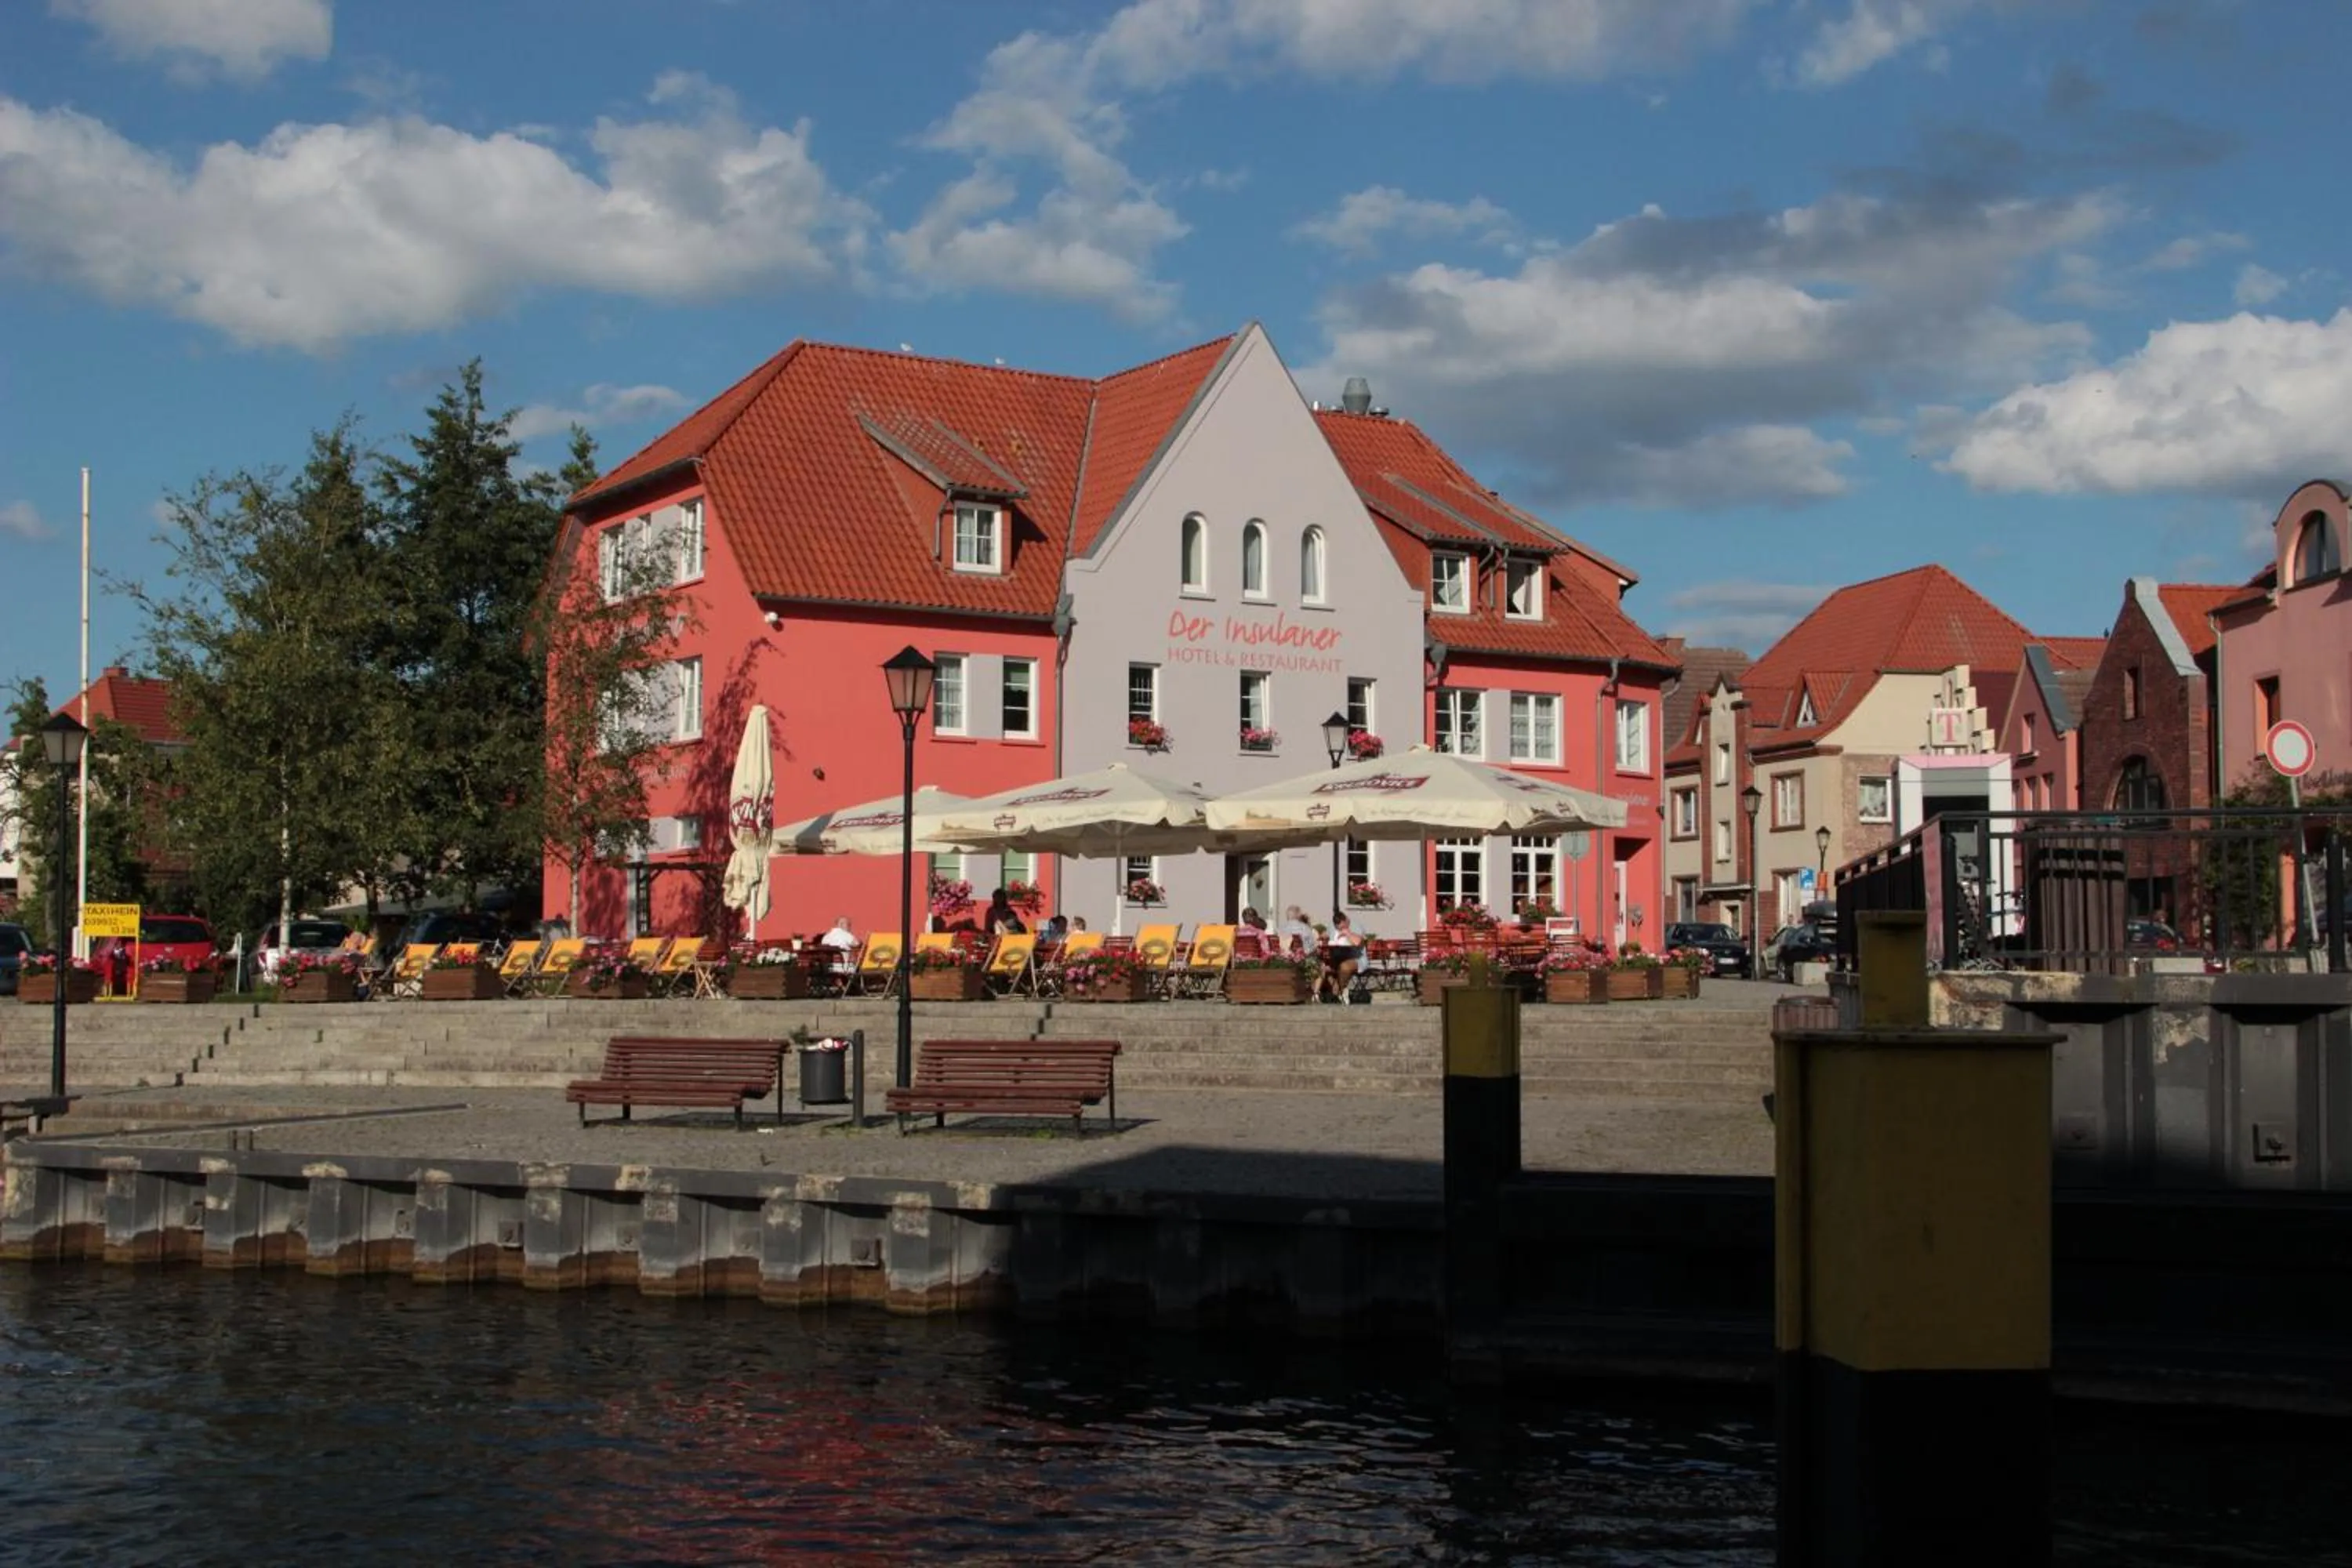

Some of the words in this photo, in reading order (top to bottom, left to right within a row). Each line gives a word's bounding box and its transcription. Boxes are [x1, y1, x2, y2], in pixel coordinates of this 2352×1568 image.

[1167, 610, 1214, 643] Der
[1225, 611, 1343, 651] Insulaner
[1167, 647, 1220, 665] HOTEL
[1223, 653, 1235, 666] &
[1240, 652, 1343, 673] RESTAURANT
[1936, 713, 1962, 742] T
